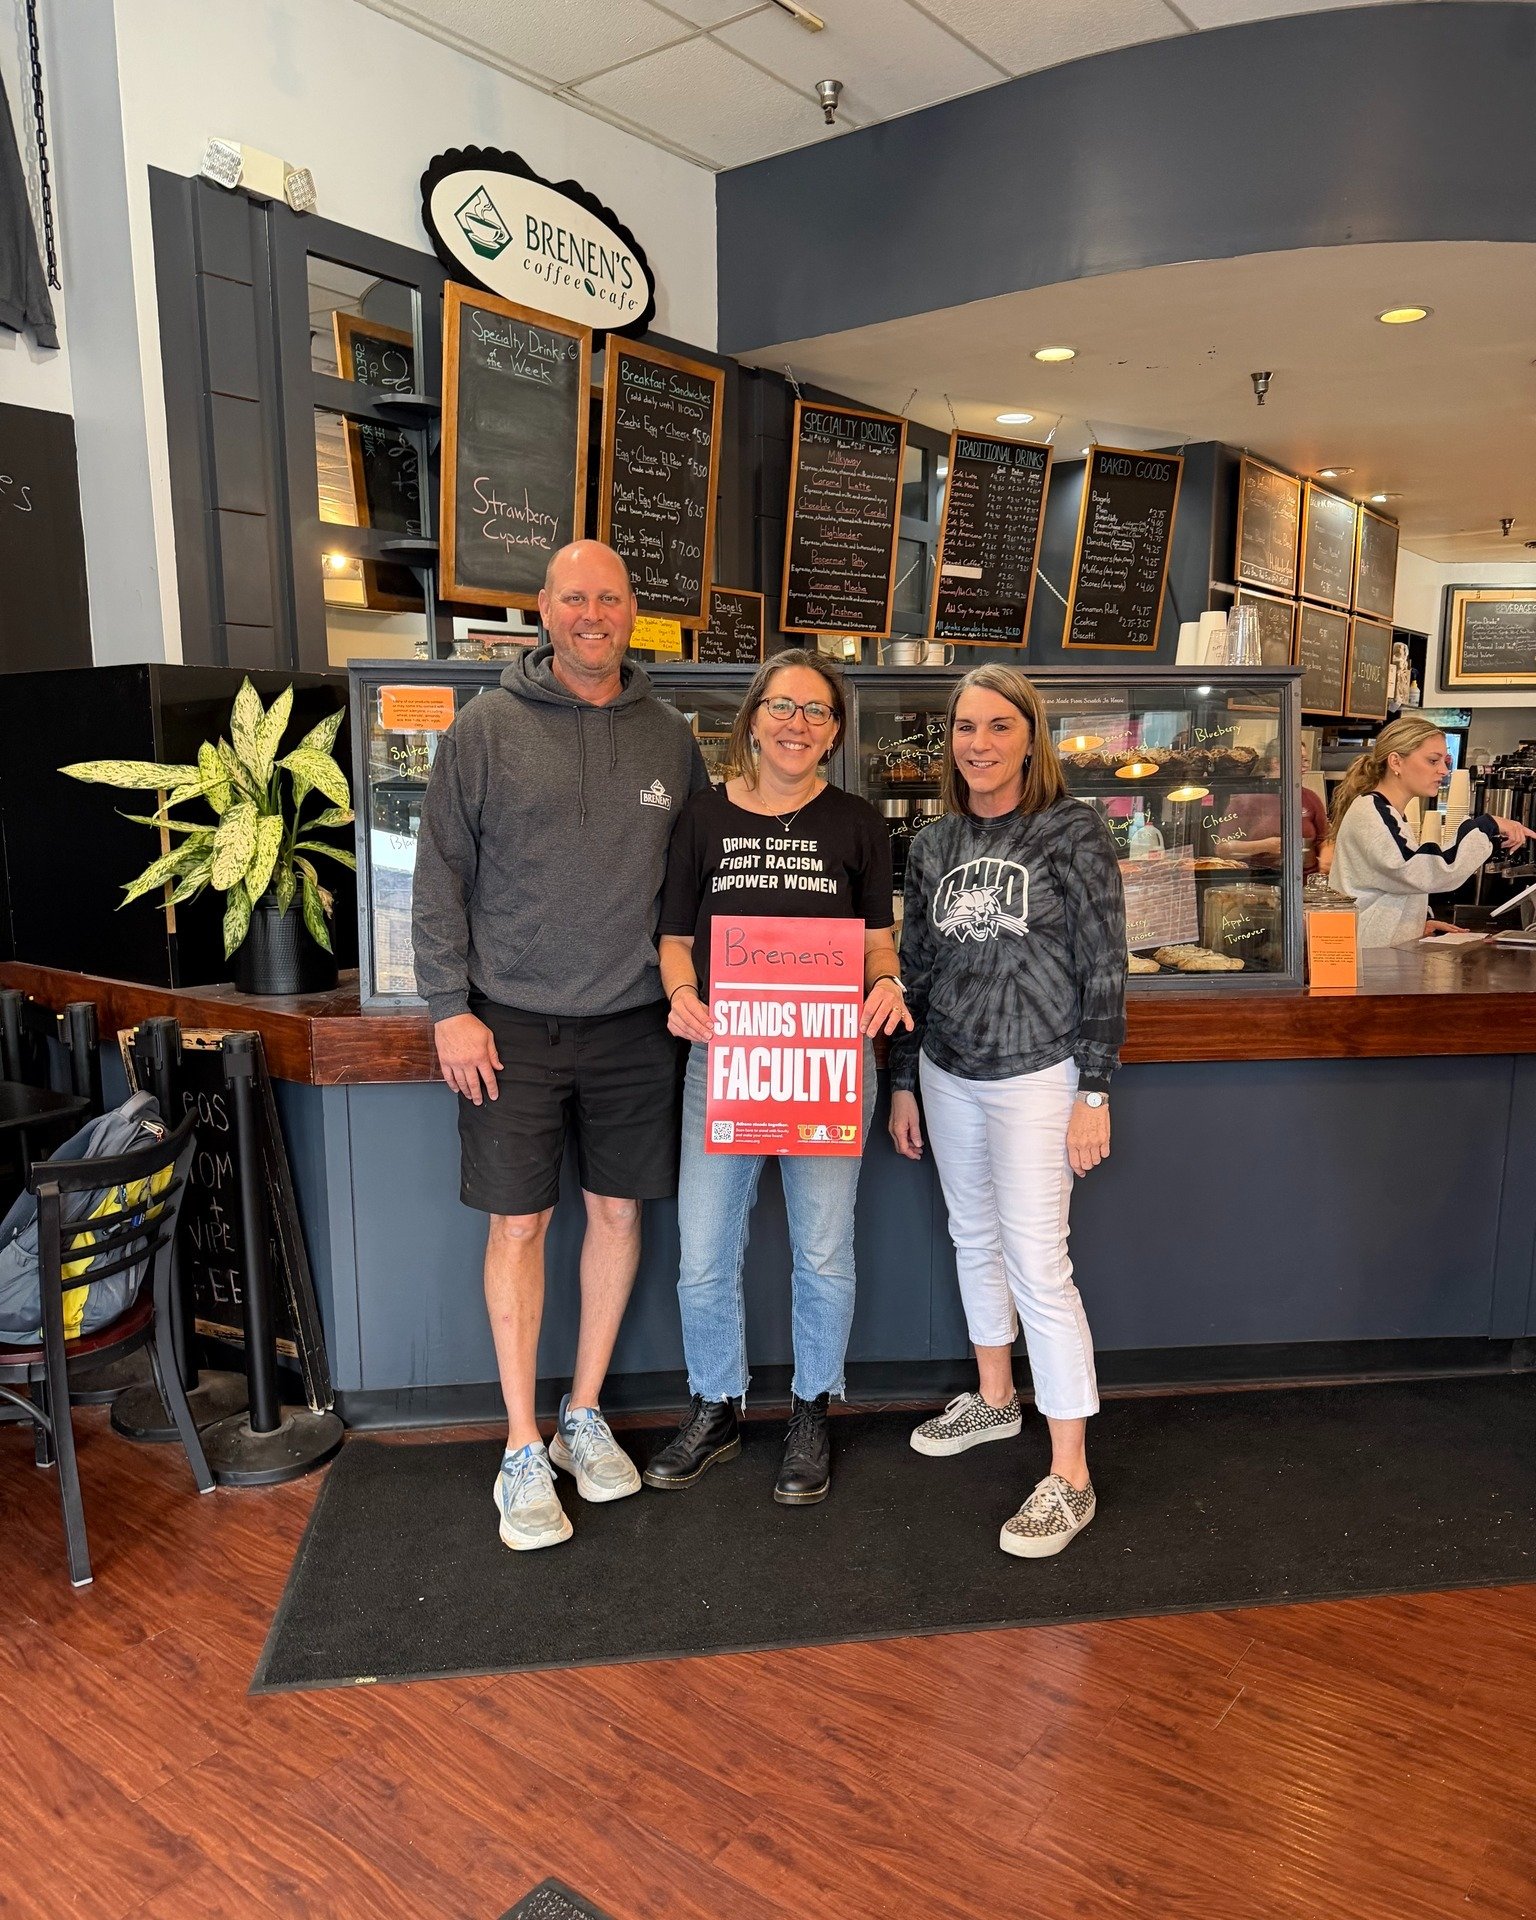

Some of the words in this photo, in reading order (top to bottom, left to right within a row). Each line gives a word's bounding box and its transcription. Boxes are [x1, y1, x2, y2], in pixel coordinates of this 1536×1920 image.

[526, 213, 634, 290] BRENEN'S
[523, 258, 581, 288] coffee
[599, 291, 637, 311] cafe
[472, 311, 525, 358] Specialty
[529, 330, 566, 362] Drinks
[487, 358, 503, 369] the
[510, 355, 552, 383] Week
[621, 360, 666, 391] Breakfast
[668, 374, 711, 404] Sandwiches
[643, 414, 658, 438] Egg
[664, 421, 692, 441] Cheese
[803, 411, 859, 438] SPECIALTY
[860, 421, 896, 444] DRINKS
[615, 438, 630, 462] Egg
[635, 444, 659, 464] Cheese
[957, 439, 1013, 464] TRADITIONAL
[1015, 448, 1046, 469] DRINKS
[1099, 456, 1132, 477] BAKED
[1135, 461, 1172, 482] GOODS
[613, 481, 638, 505] Meat,
[637, 486, 652, 509] Egg
[656, 491, 682, 511] Cheese
[798, 496, 831, 511] Chocolate
[835, 500, 861, 517] Cherry
[1092, 490, 1111, 504] Bagels
[472, 477, 559, 543] Strawberry
[482, 518, 552, 553] Cupcake
[611, 523, 636, 546] Triple
[638, 528, 664, 549] Special
[670, 539, 701, 559] $7.00
[820, 524, 864, 541] Highlander
[644, 565, 670, 588] Deluxe
[673, 572, 699, 591] $7.00
[1080, 562, 1104, 576] Muffins
[1080, 576, 1101, 588] Scones
[714, 592, 743, 612] Bagels
[1074, 602, 1104, 615] Cinnamon
[1104, 602, 1120, 616] Rolls
[1073, 616, 1099, 628] Cookies
[1072, 627, 1097, 641] Biscotti
[877, 732, 925, 752] Cinnamon
[1103, 729, 1134, 744] emon
[1194, 724, 1242, 743] Blueberry
[390, 741, 431, 760] Salted
[885, 749, 921, 768] Coffee
[926, 737, 947, 753] Cak
[1202, 812, 1239, 830] Cheese
[722, 837, 761, 854] DRINK
[765, 837, 818, 853] COFFEE
[1210, 826, 1248, 846] Danish
[720, 854, 761, 871] FIGHT
[765, 854, 823, 872] RACISM
[711, 874, 779, 894] EMPOWER
[783, 874, 837, 895] WOMEN
[1221, 914, 1251, 932] Apple
[1224, 926, 1266, 945] Turnover
[724, 926, 845, 968] Brenen's
[713, 999, 796, 1039] STANDS
[799, 1001, 859, 1040] WITH
[711, 1045, 858, 1104] FACULTY!
